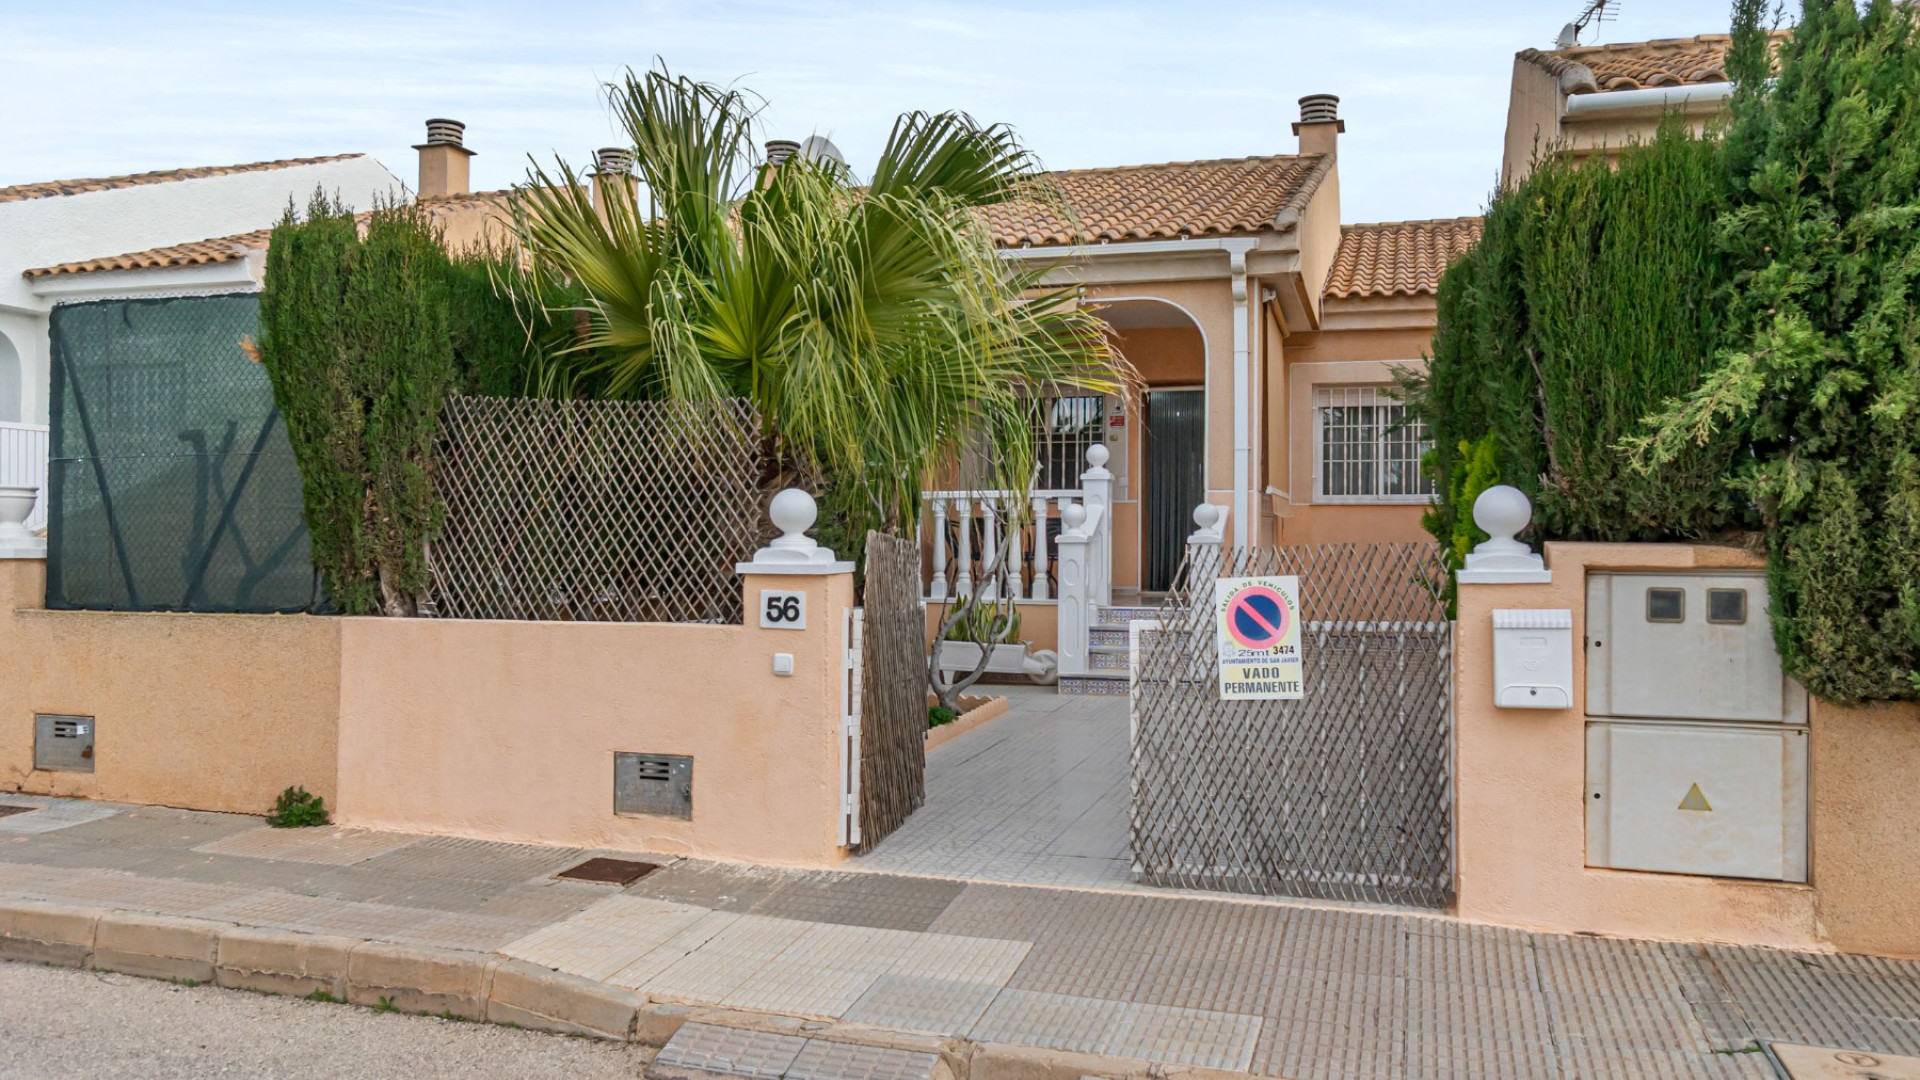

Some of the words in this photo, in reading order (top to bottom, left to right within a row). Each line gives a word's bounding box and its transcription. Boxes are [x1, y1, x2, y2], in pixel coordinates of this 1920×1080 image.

[1221, 587, 1239, 612] SALIDA
[1258, 580, 1295, 611] VEHICULOS
[766, 596, 800, 622] 56
[1273, 645, 1295, 655] 3474
[1243, 667, 1280, 679] VADO
[1224, 681, 1300, 694] PERMANENTE
